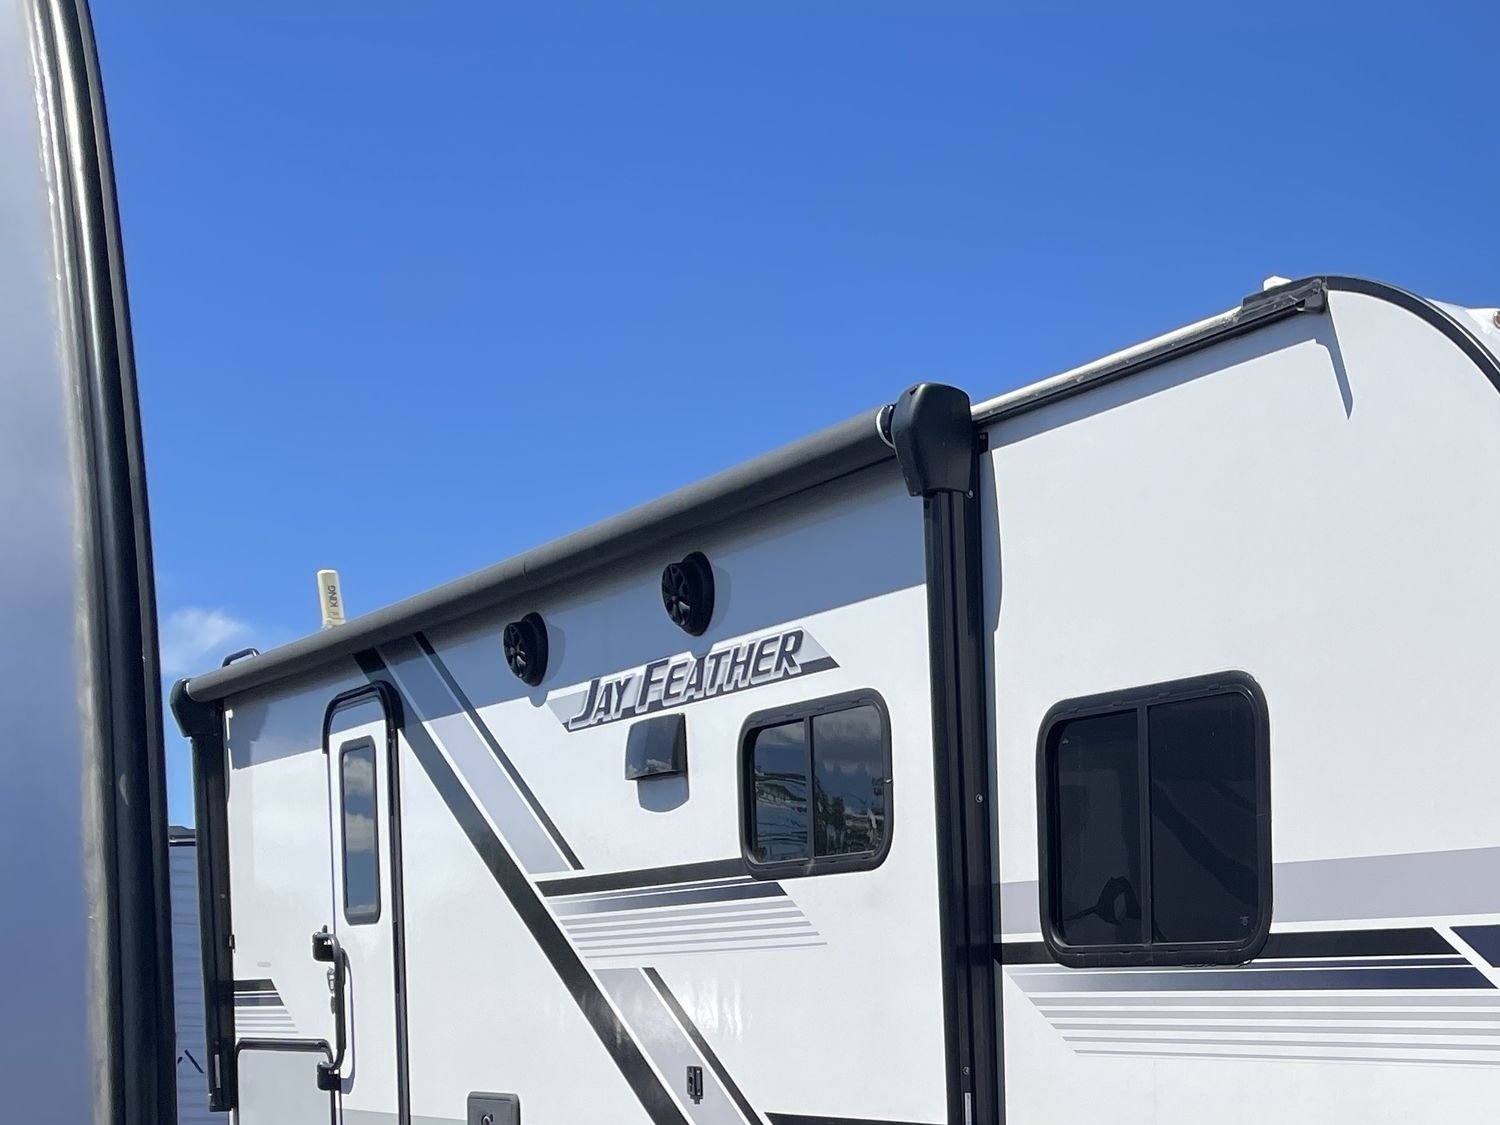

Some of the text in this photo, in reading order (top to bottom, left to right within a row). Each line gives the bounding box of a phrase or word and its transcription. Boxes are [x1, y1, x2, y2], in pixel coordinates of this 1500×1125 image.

[328, 585, 339, 608] KING
[569, 629, 805, 730] JAY FEATHER
